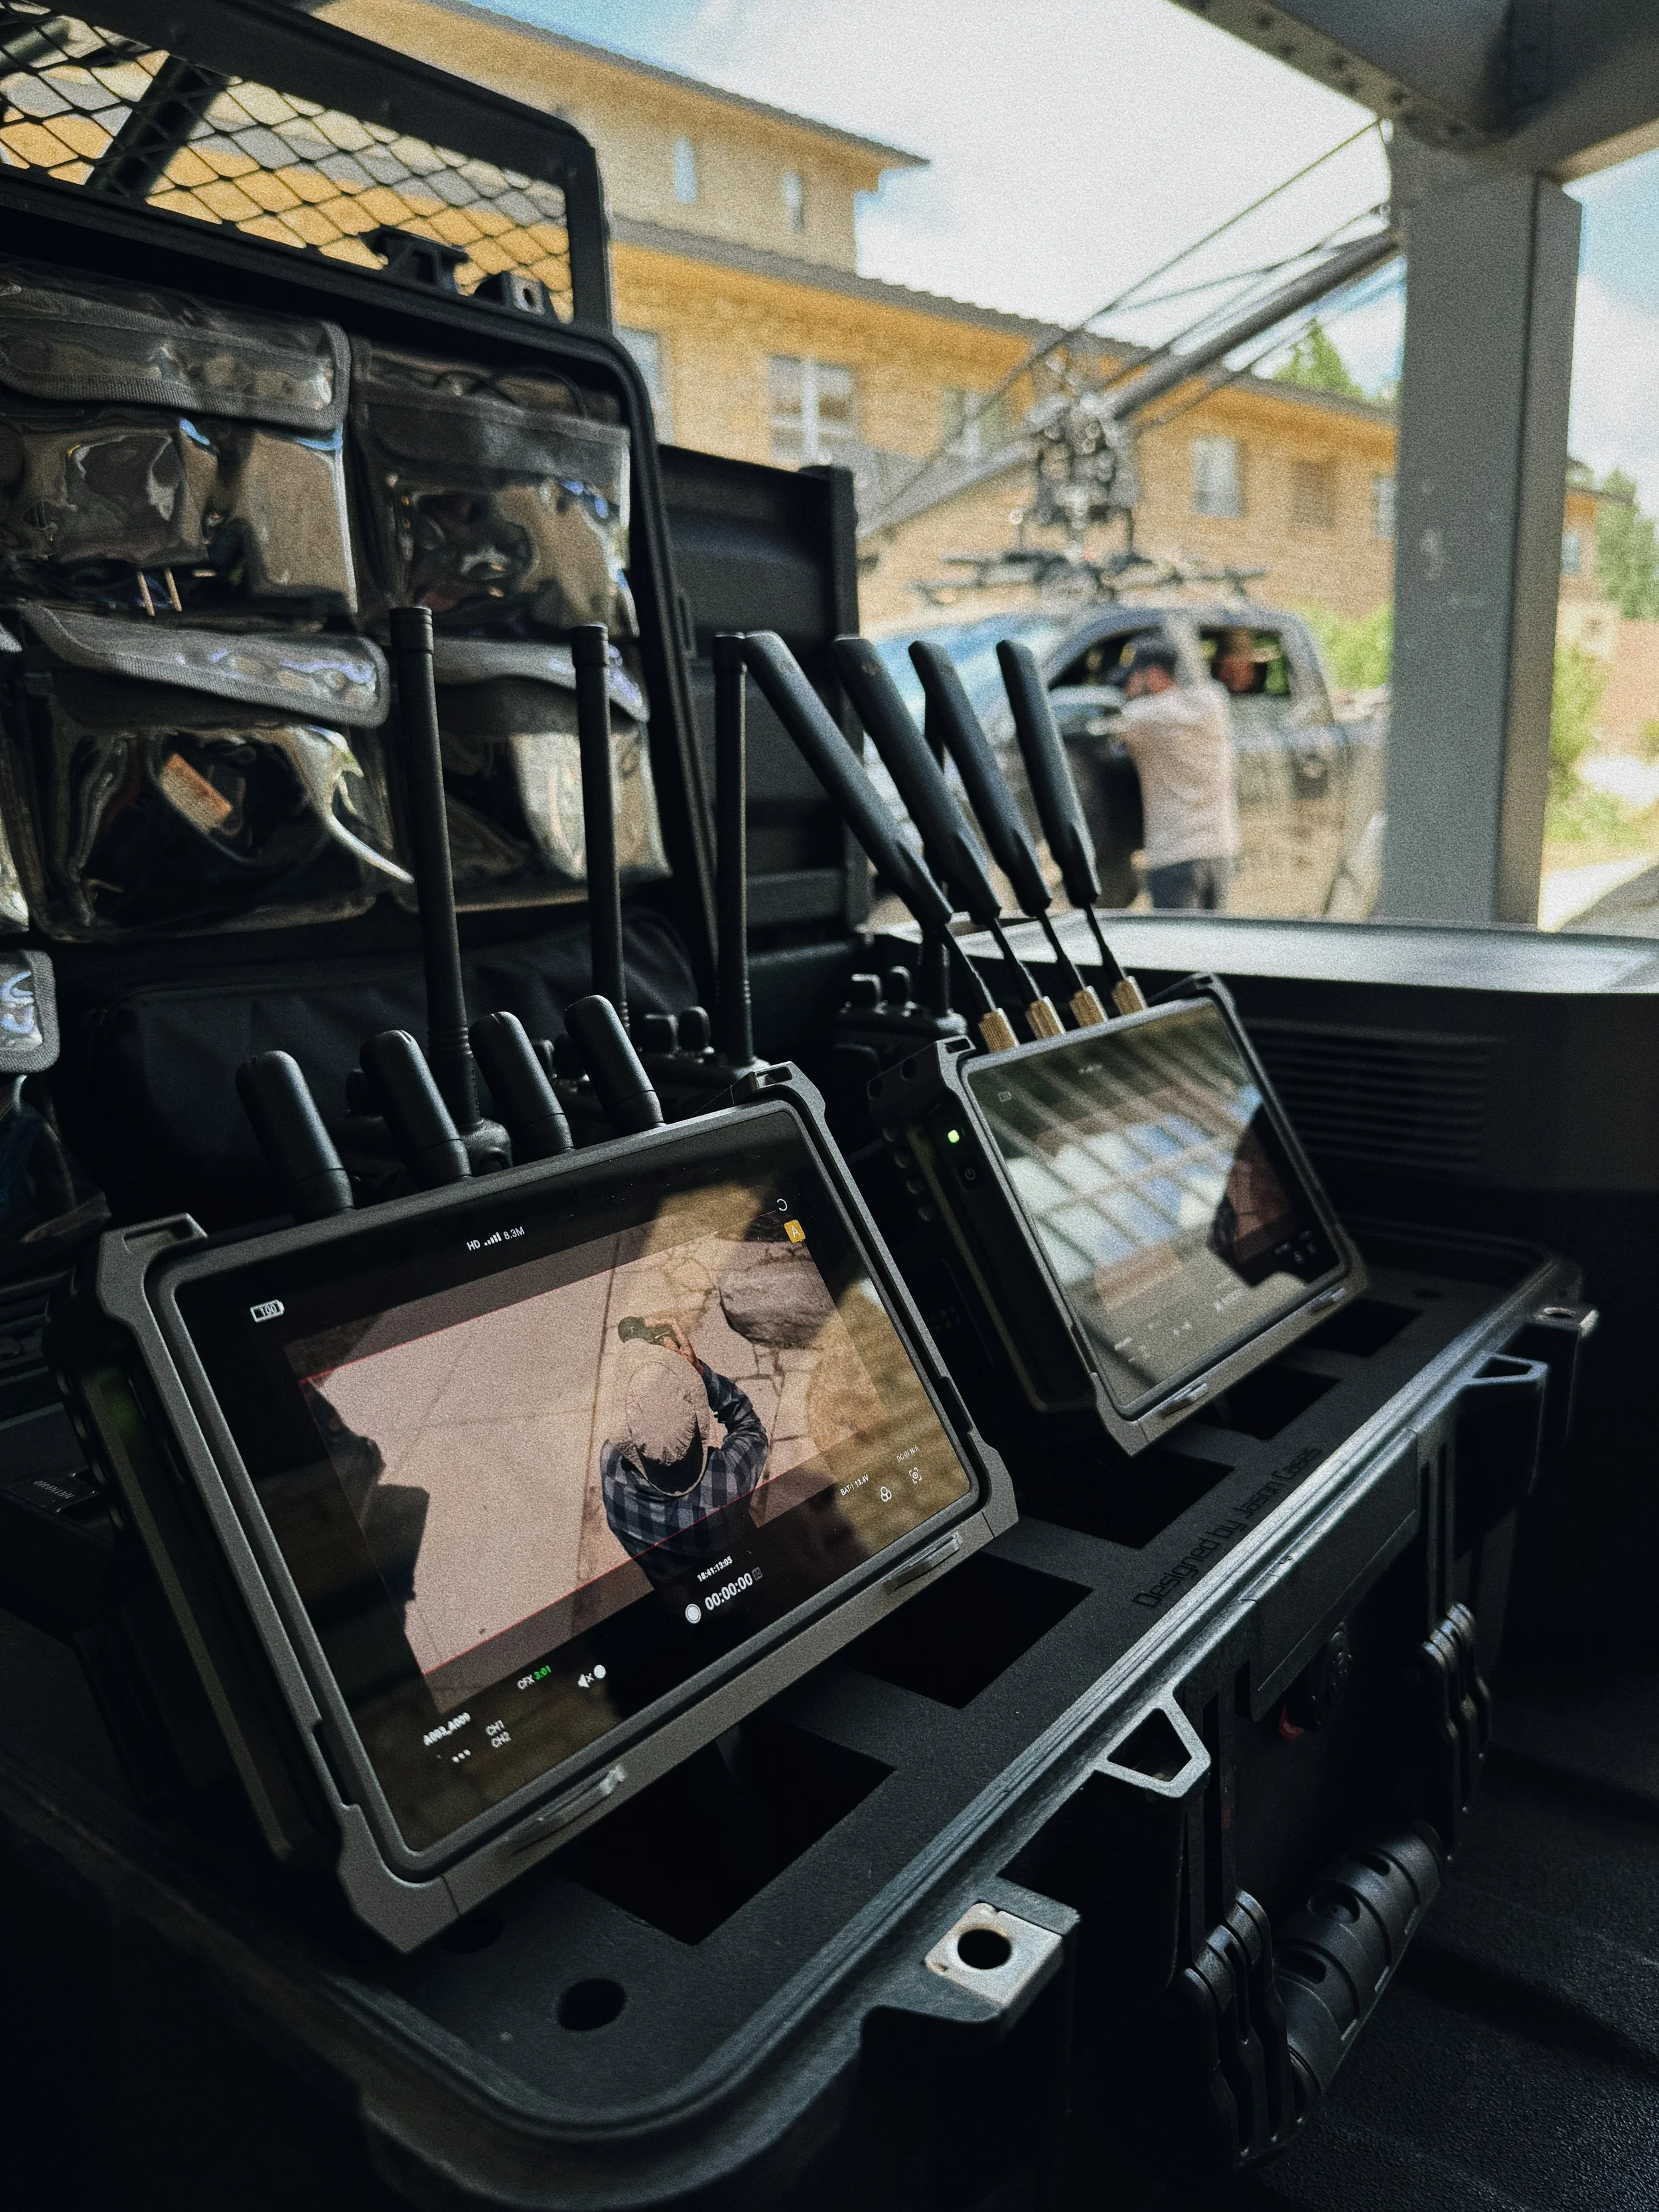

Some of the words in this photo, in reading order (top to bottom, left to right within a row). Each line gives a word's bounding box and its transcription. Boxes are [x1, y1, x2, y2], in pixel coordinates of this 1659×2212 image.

[467, 1240, 480, 1251] HD
[503, 1226, 525, 1240] 8.3M
[791, 1225, 801, 1238] A
[259, 1303, 277, 1317] 100
[855, 1474, 869, 1487] 13.4V
[1131, 1537, 1220, 1608] Designed
[1205, 1519, 1248, 1539] by
[1232, 1481, 1289, 1519] Jason
[1271, 1447, 1322, 1480] Cases
[697, 1556, 733, 1582] 18:41:13:05
[705, 1572, 753, 1611] 00:00:00
[517, 1674, 536, 1690] CFX
[534, 1665, 552, 1680] 3:01
[485, 1720, 505, 1736] CH1
[490, 1732, 512, 1748] CH2
